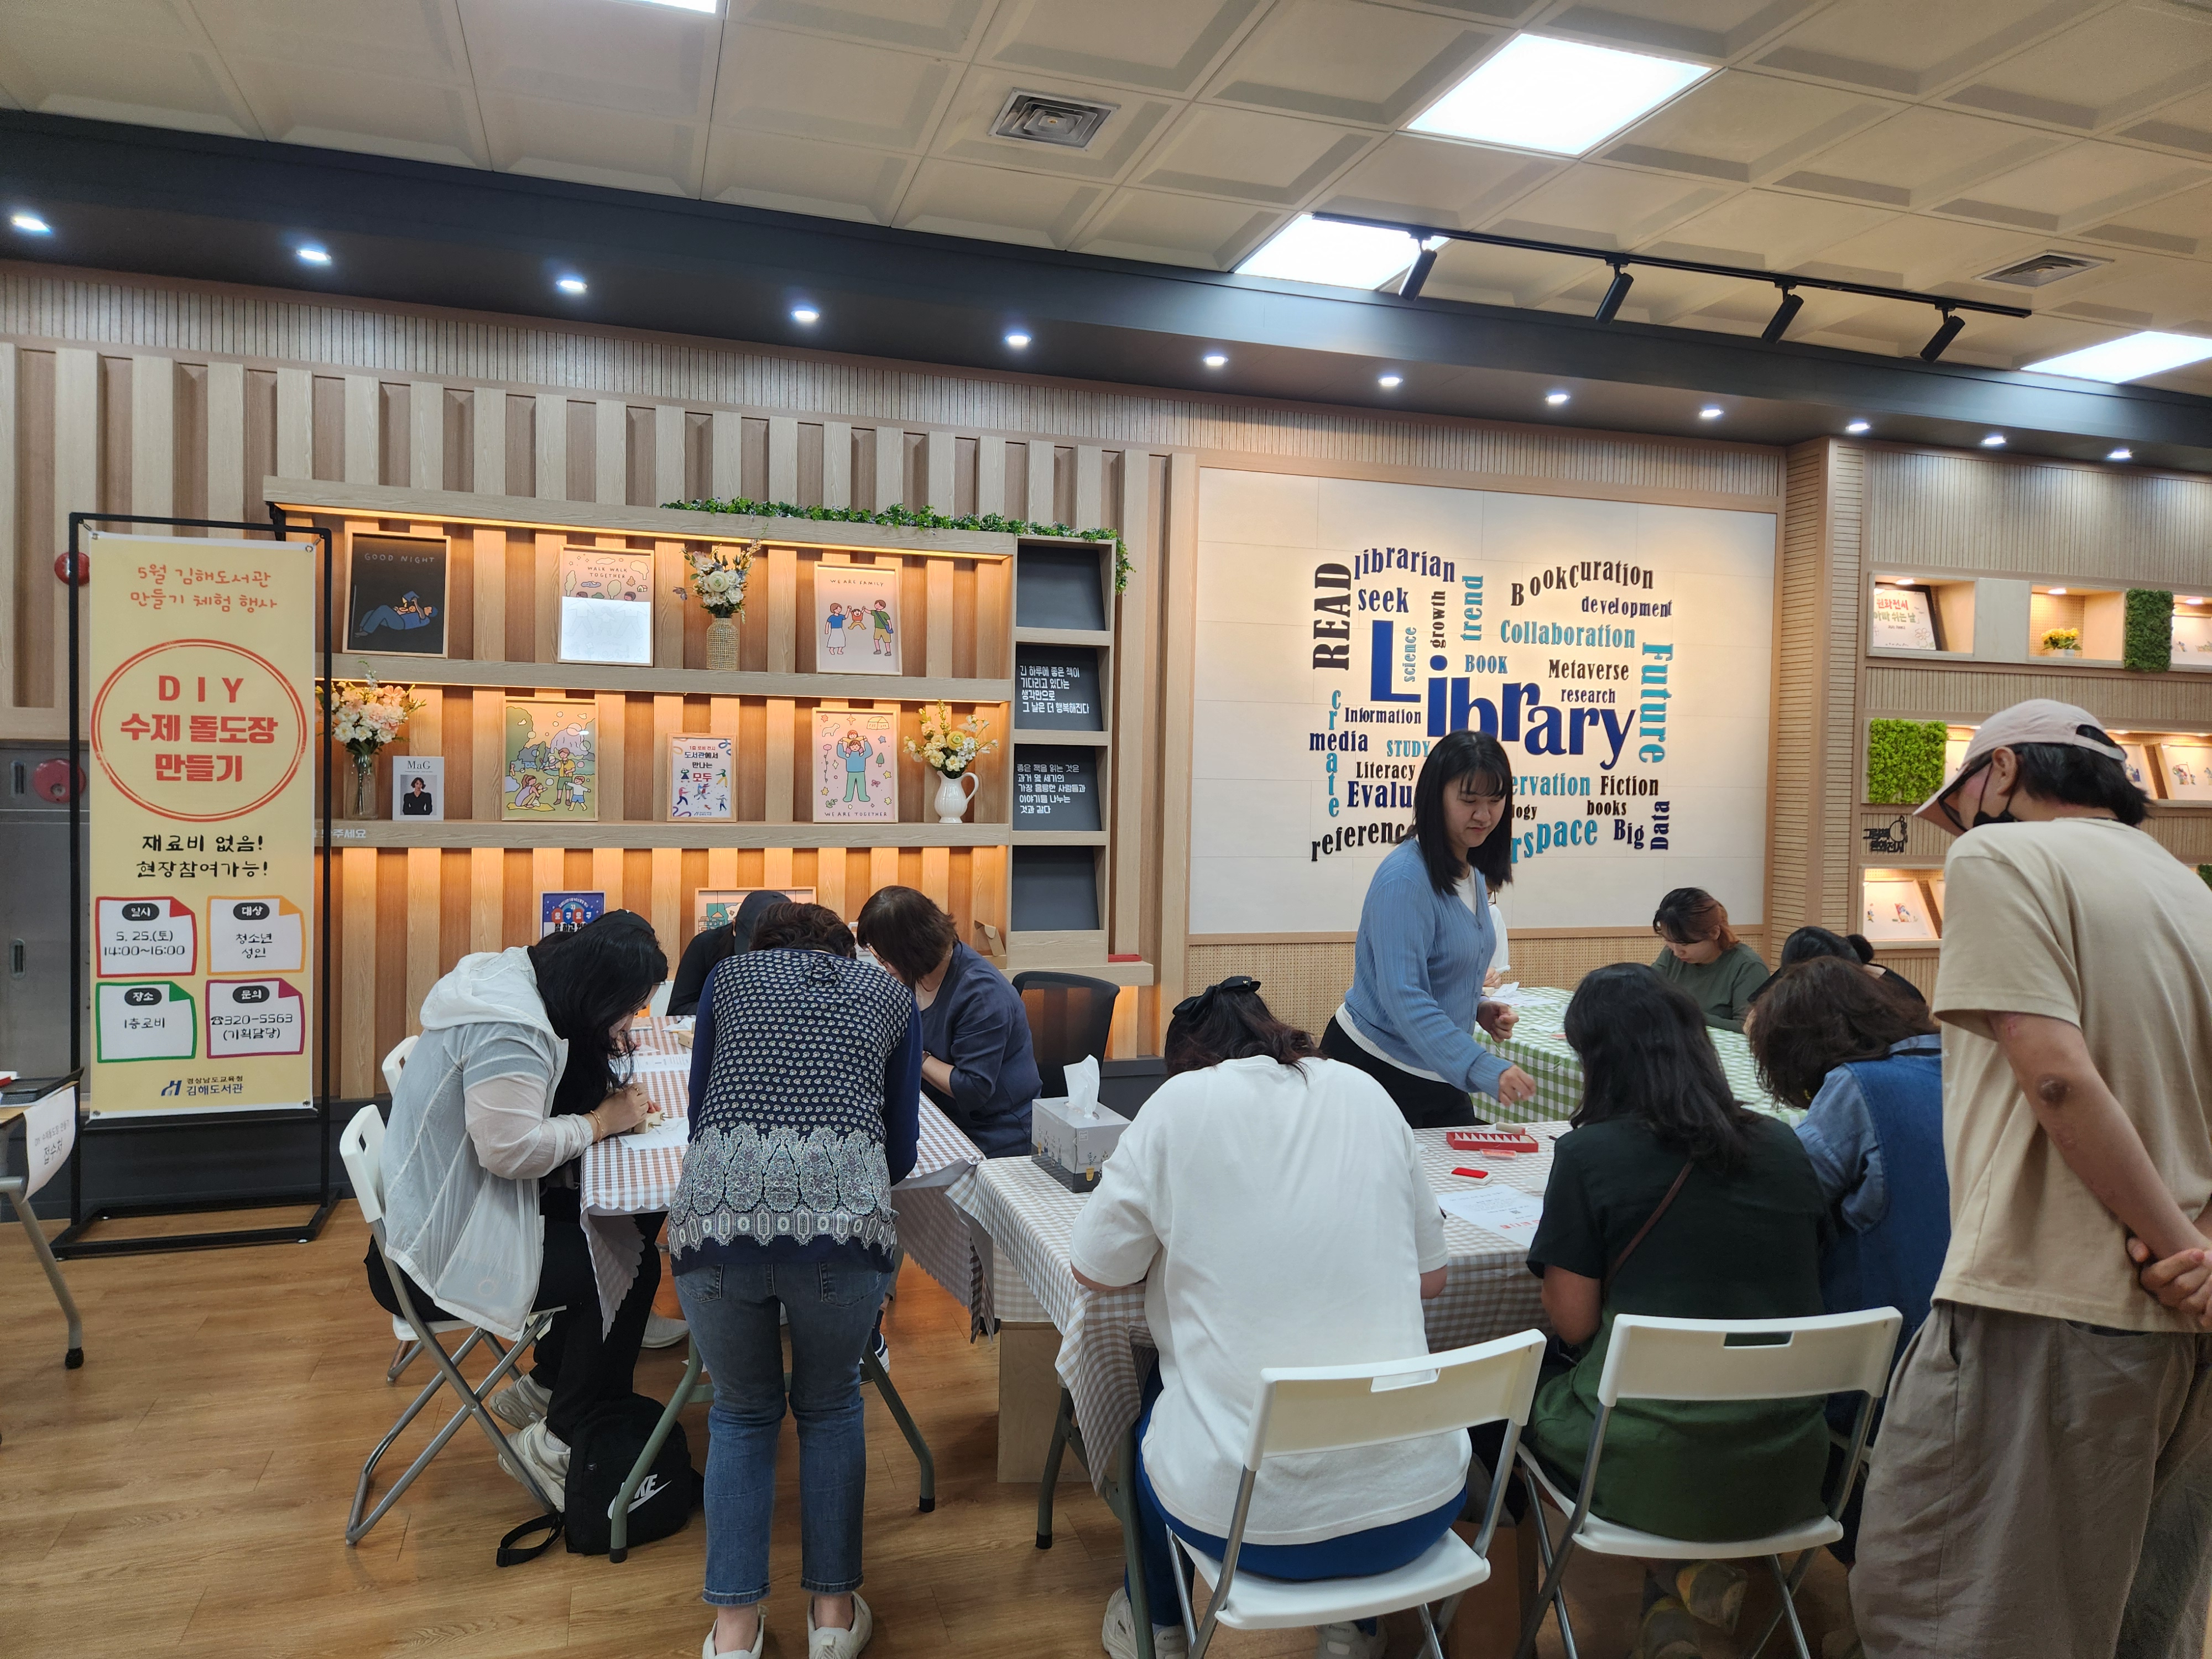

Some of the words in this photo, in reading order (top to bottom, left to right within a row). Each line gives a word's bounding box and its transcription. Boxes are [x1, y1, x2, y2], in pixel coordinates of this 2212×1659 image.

[1354, 547, 1455, 582] librarian
[138, 564, 166, 584] 5월
[175, 568, 271, 587] 김해도서관
[131, 588, 185, 609] 만들기
[194, 593, 231, 612] 체험
[239, 595, 278, 613] 행사
[1358, 587, 1409, 613] seek
[1460, 576, 1483, 641] trend
[1581, 596, 1673, 618] development
[1313, 563, 1352, 670] READ
[1430, 591, 1446, 649] growth
[1892, 612, 1907, 622] 쉬는
[1501, 619, 1636, 648] Collaboration
[1404, 627, 1417, 682] science
[1019, 665, 1027, 676] 긴
[1029, 665, 1049, 677] 하루에
[1051, 666, 1065, 677] 좋은
[1066, 667, 1080, 678] 책이
[1465, 654, 1508, 675] BOOK
[1548, 659, 1629, 681] Metaverse
[1020, 677, 1048, 688] 기다리고
[1050, 679, 1070, 689] 있다는
[1022, 690, 1056, 701] 생각만으로
[1370, 620, 1637, 770] Library
[1561, 688, 1615, 703] research
[1639, 642, 1674, 763] Future
[1022, 702, 1030, 713] 그
[1031, 702, 1045, 713] 날은
[1047, 702, 1054, 713] 더
[1056, 702, 1089, 714] 행복해진다
[1344, 707, 1422, 725] Information
[121, 713, 180, 742] 수제
[189, 716, 278, 744] 돌도장
[1310, 731, 1368, 752] media
[1387, 739, 1431, 757] STUDY
[155, 754, 243, 782] 만들기
[407, 760, 431, 769] MaG
[1016, 764, 1031, 773] 좋은
[1033, 764, 1047, 773] 책을
[1049, 764, 1063, 773] 읽는
[1065, 764, 1079, 773] 것은
[1356, 761, 1416, 781] Literacy
[692, 773, 712, 782] 모두
[1018, 774, 1032, 782] 과거
[1044, 774, 1065, 782] 세기의
[1512, 773, 1590, 796] ervation
[1600, 775, 1659, 796] Fiction
[1018, 784, 1033, 792] 가장
[1035, 784, 1056, 792] 훌륭한
[1058, 784, 1086, 792] 사람들과
[1347, 781, 1412, 808] Evalu
[1019, 795, 1048, 803] 이야기를
[1050, 795, 1071, 803] 나누는
[1020, 805, 1035, 813] 것과
[1036, 805, 1051, 813] 같다
[1512, 804, 1537, 820] logy
[1587, 800, 1627, 817] books
[322, 828, 366, 838] 주세요
[1650, 800, 1671, 851] Data
[142, 834, 205, 852] 재료비
[215, 835, 264, 852] 없음!
[1311, 822, 1405, 862] referenc
[1511, 819, 1598, 864] rspace
[1614, 818, 1645, 851] Big
[137, 861, 268, 878] 현장참여가능!
[131, 906, 152, 917] 일시
[241, 906, 263, 916] 대상
[236, 932, 273, 944] 청소년
[104, 945, 185, 956] 14:00~16:00
[242, 947, 267, 958] 성인
[133, 992, 154, 1001] 장소
[241, 990, 262, 1000] 문의
[124, 1017, 165, 1029] 1층로비
[223, 1027, 281, 1041] (기획담당)
[187, 1076, 243, 1084] 경상남도교육청
[186, 1083, 243, 1096] 김해도서관
